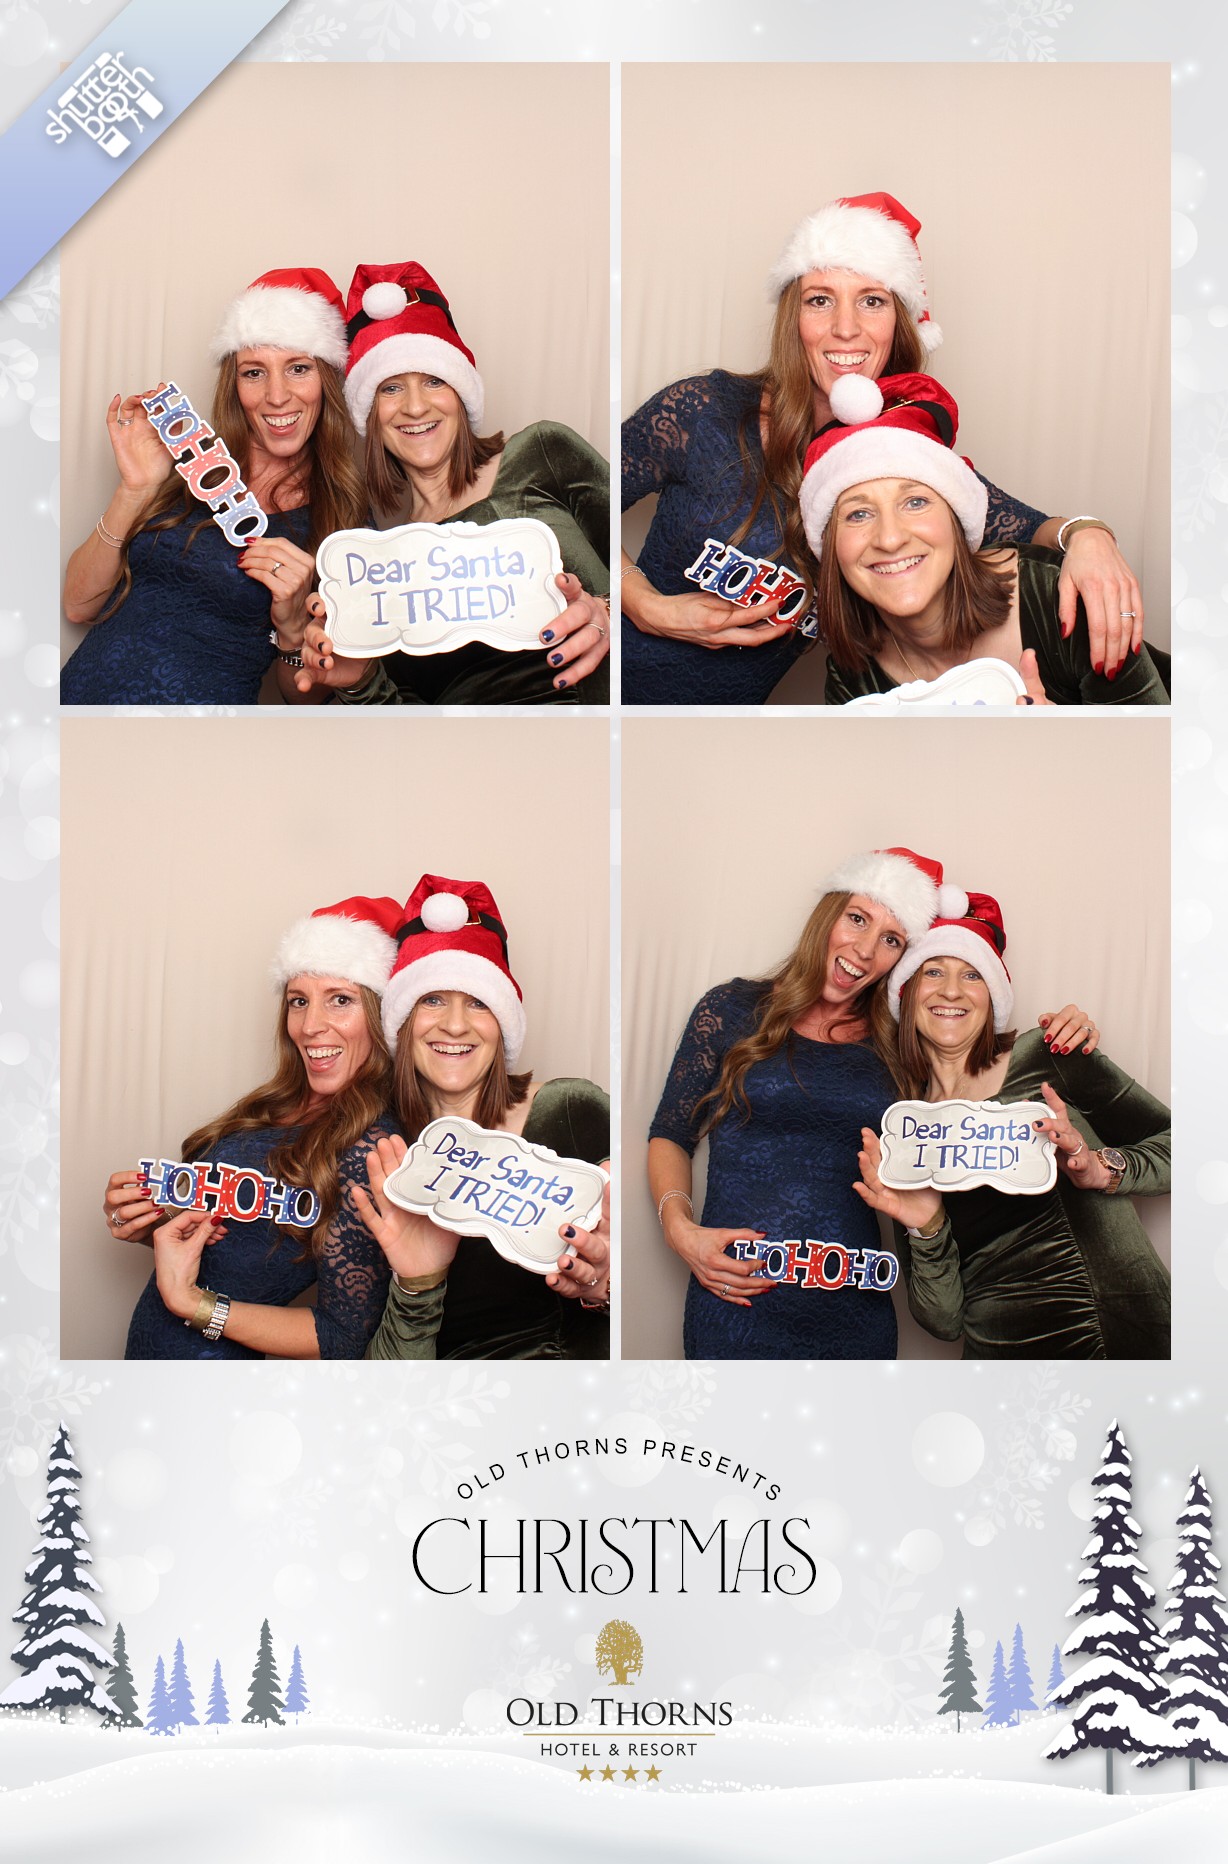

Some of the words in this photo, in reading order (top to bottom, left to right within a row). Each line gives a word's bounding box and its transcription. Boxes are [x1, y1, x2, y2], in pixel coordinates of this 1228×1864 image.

[346, 553, 416, 586] Dear
[428, 546, 535, 581] Santa,
[371, 591, 389, 625] I
[399, 584, 516, 625] TRIED!
[903, 1116, 952, 1139] Dear
[960, 1116, 1037, 1144] Santa,
[433, 1133, 490, 1171] Dear
[490, 1155, 575, 1212] Santa,
[913, 1144, 928, 1167] I
[936, 1144, 1019, 1170] TRIED!
[424, 1165, 452, 1191] I
[449, 1175, 546, 1233] TRIED!
